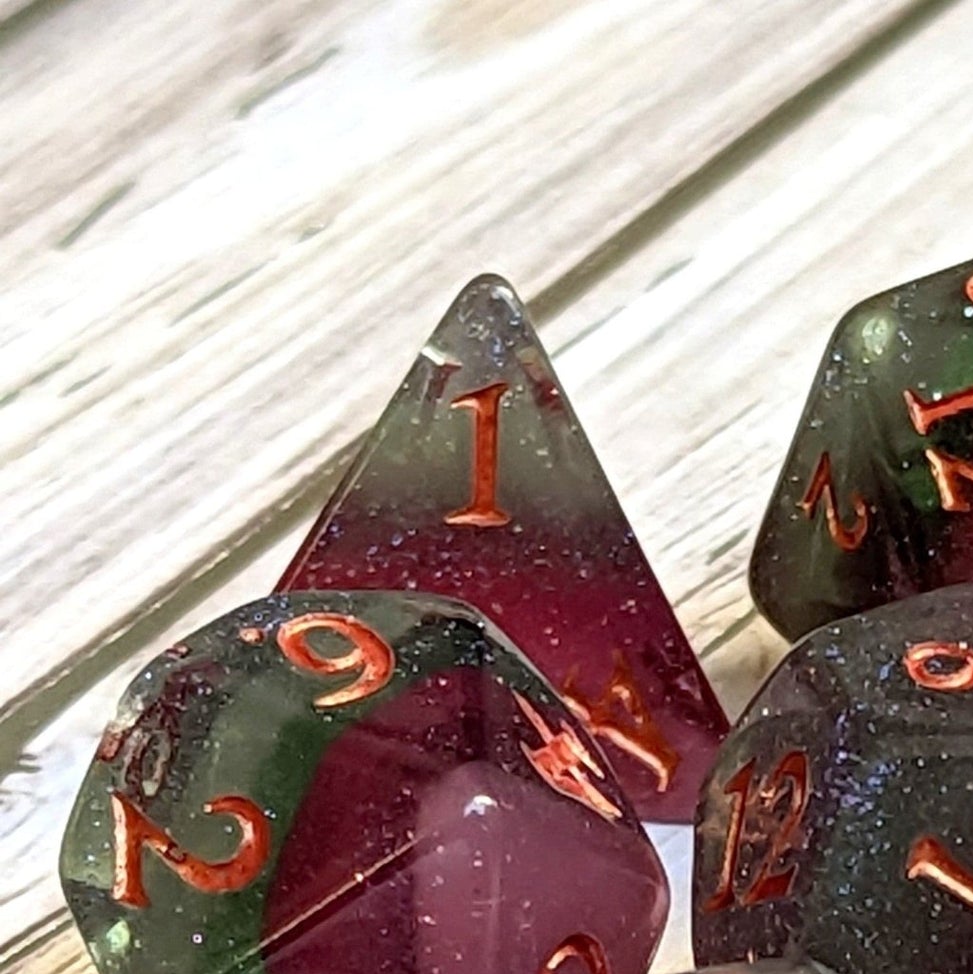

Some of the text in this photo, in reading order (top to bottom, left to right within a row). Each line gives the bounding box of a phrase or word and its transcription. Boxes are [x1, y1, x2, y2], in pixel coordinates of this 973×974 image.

[444, 381, 511, 527] 1
[801, 450, 868, 554] 2
[111, 794, 271, 909] 2
[702, 748, 811, 913] 12
